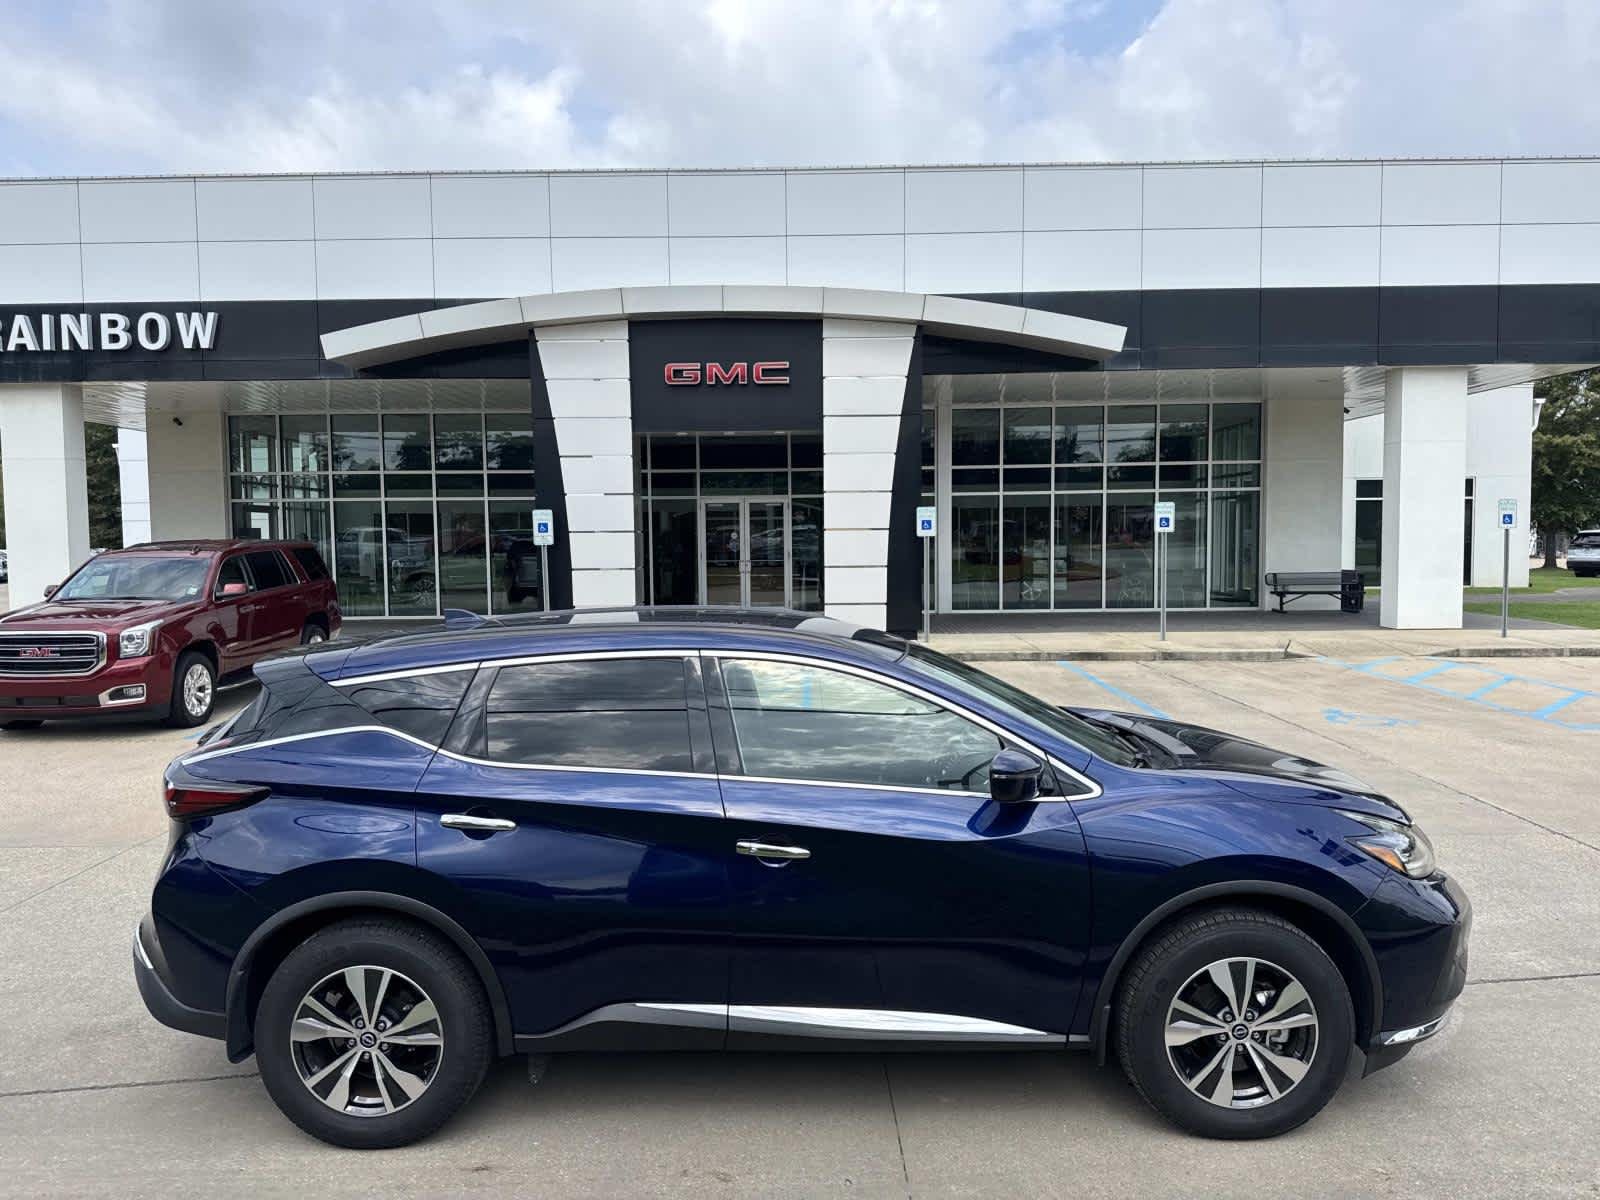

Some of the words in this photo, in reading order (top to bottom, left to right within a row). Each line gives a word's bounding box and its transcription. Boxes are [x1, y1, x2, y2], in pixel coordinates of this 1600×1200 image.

[0, 312, 218, 351] AINBOW
[664, 361, 790, 385] GMC
[20, 647, 60, 657] GMC
